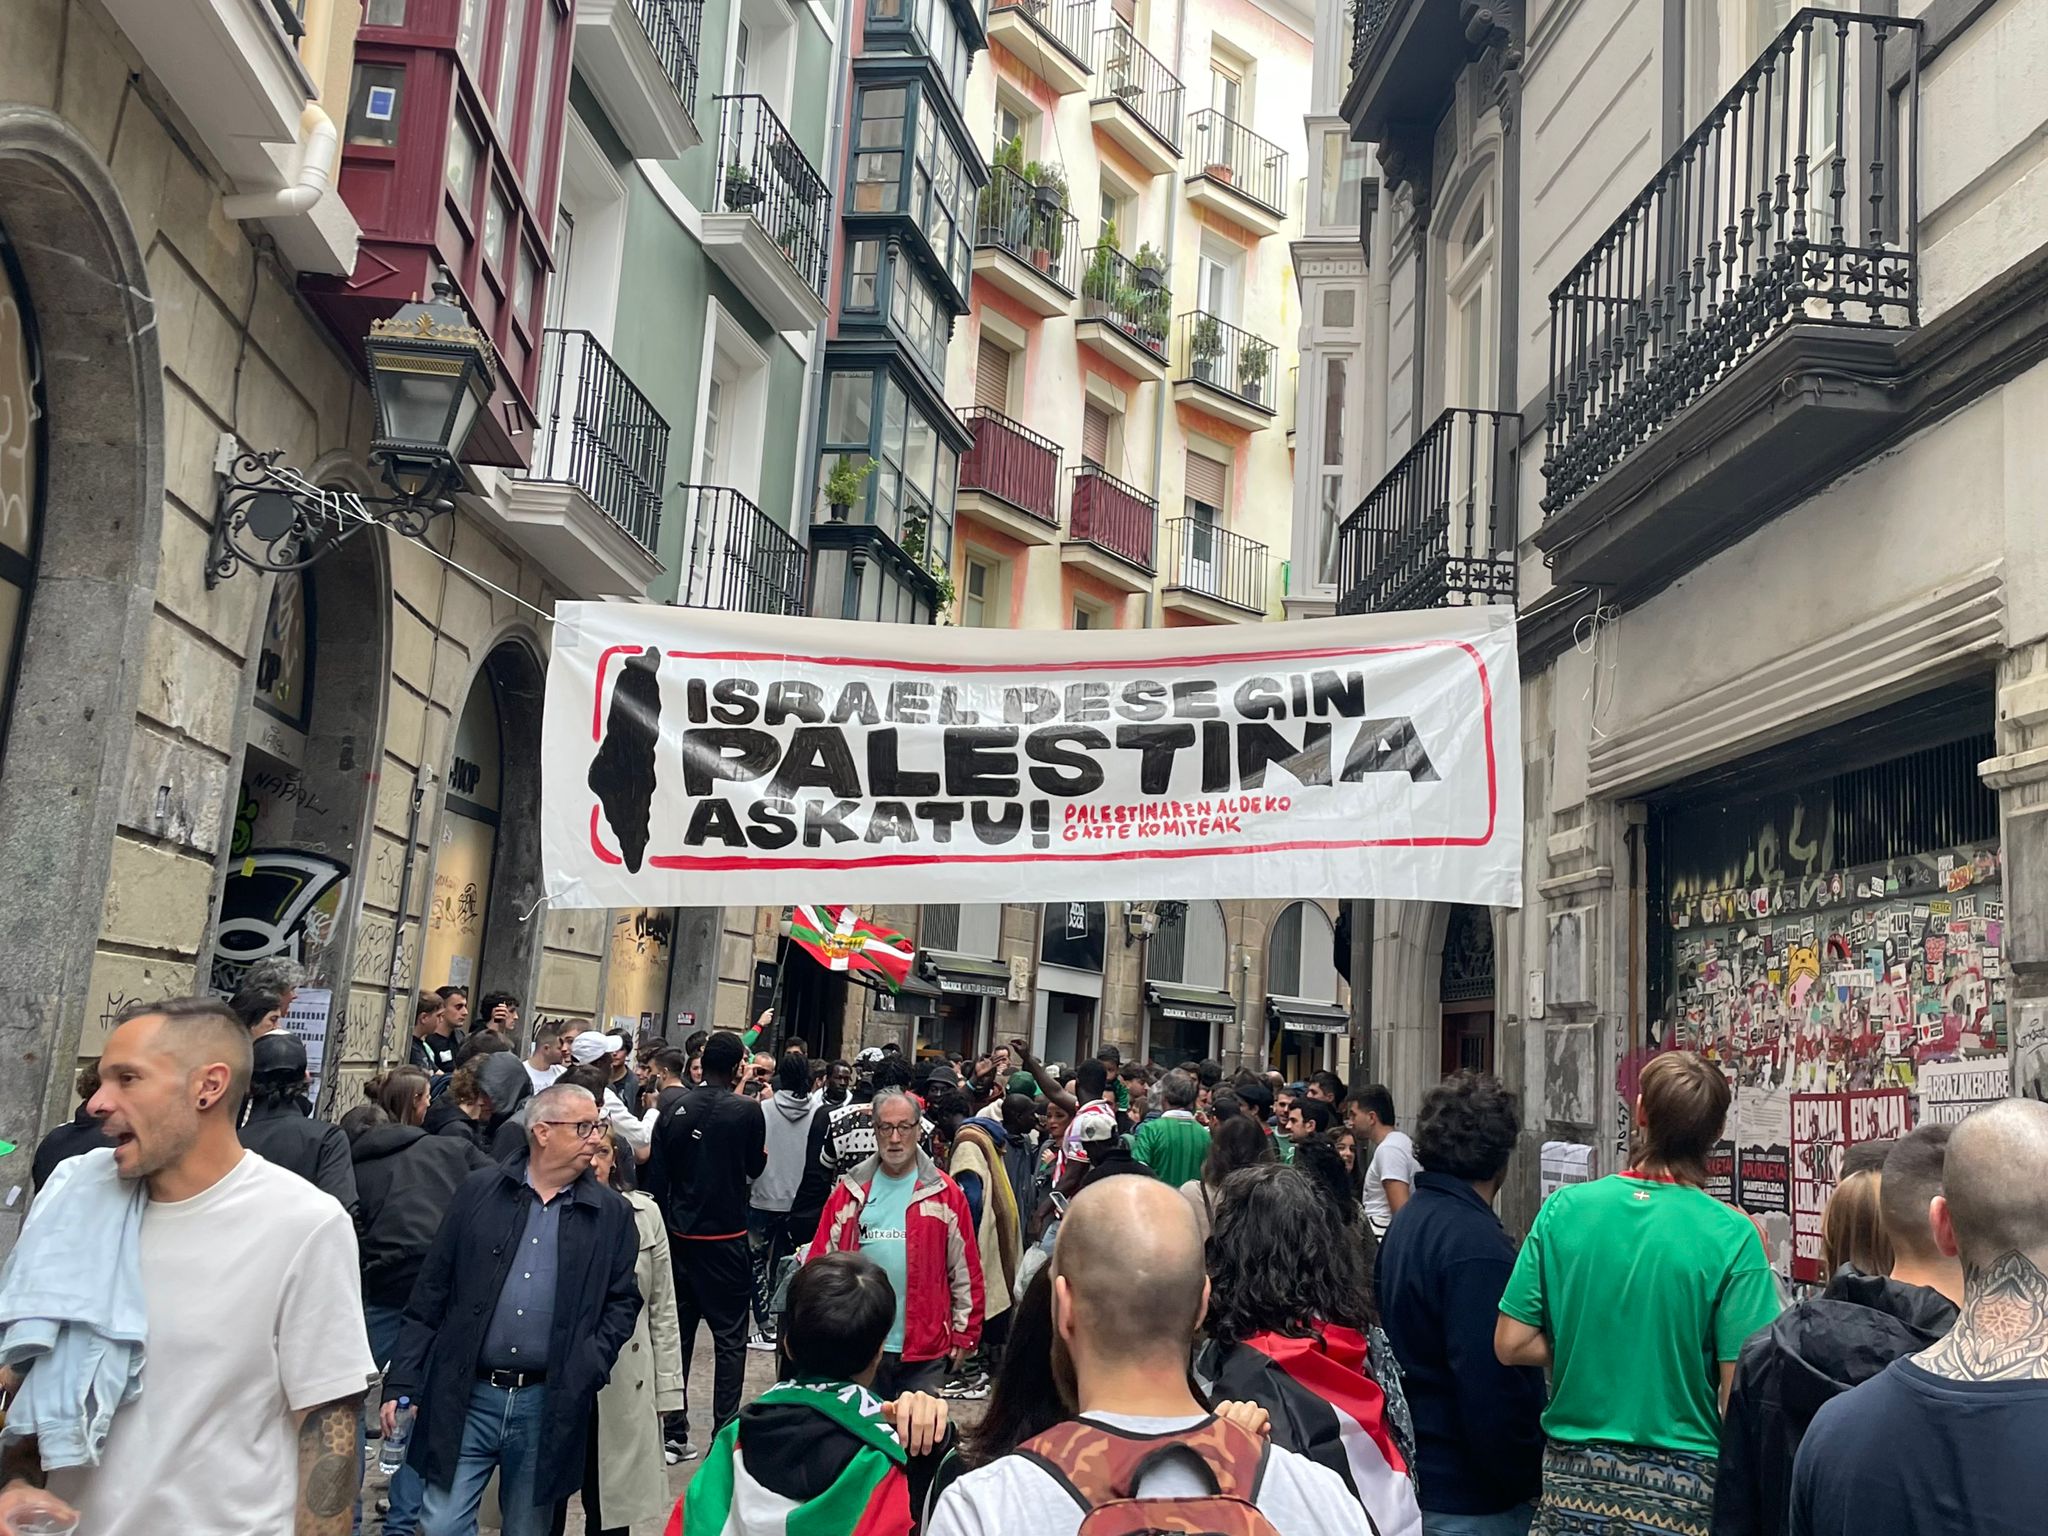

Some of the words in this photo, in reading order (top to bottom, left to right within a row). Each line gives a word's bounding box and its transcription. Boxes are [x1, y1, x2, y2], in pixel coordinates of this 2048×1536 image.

[687, 678, 980, 728] ISRAEL
[1003, 670, 1366, 725] DESEGIN
[683, 716, 1442, 798] PALESTINA
[684, 798, 1050, 850] ASKATU!
[1062, 823, 1130, 841] GAZTE
[1138, 815, 1242, 838] KOMITEAK
[1064, 800, 1210, 825] PALESTINAREN
[1216, 796, 1292, 814] ALDEKO
[1793, 1100, 1845, 1142] EUSKAL
[1850, 1095, 1908, 1140] EUSKAL
